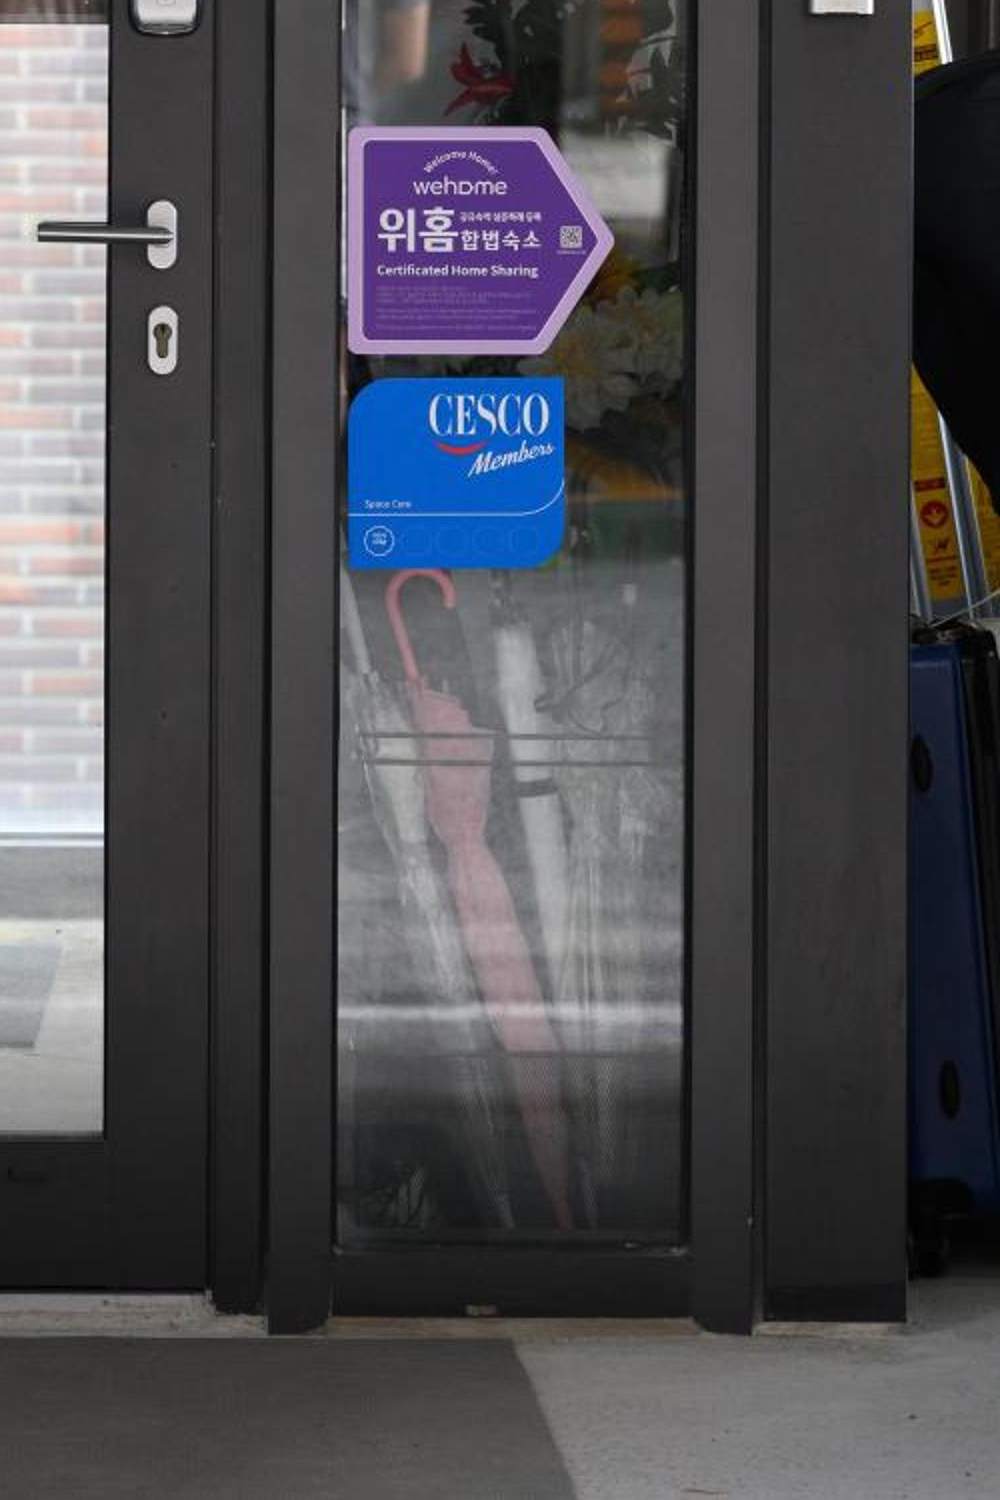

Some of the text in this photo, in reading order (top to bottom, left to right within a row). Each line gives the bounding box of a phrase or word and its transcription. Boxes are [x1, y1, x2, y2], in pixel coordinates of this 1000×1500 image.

[423, 150, 467, 173] Welcome
[377, 206, 459, 253] 위홈
[461, 229, 542, 252] 합법숙소
[377, 263, 539, 279] Certificated Home Sharing
[428, 392, 550, 436] CESCO
[467, 439, 555, 479] Members
